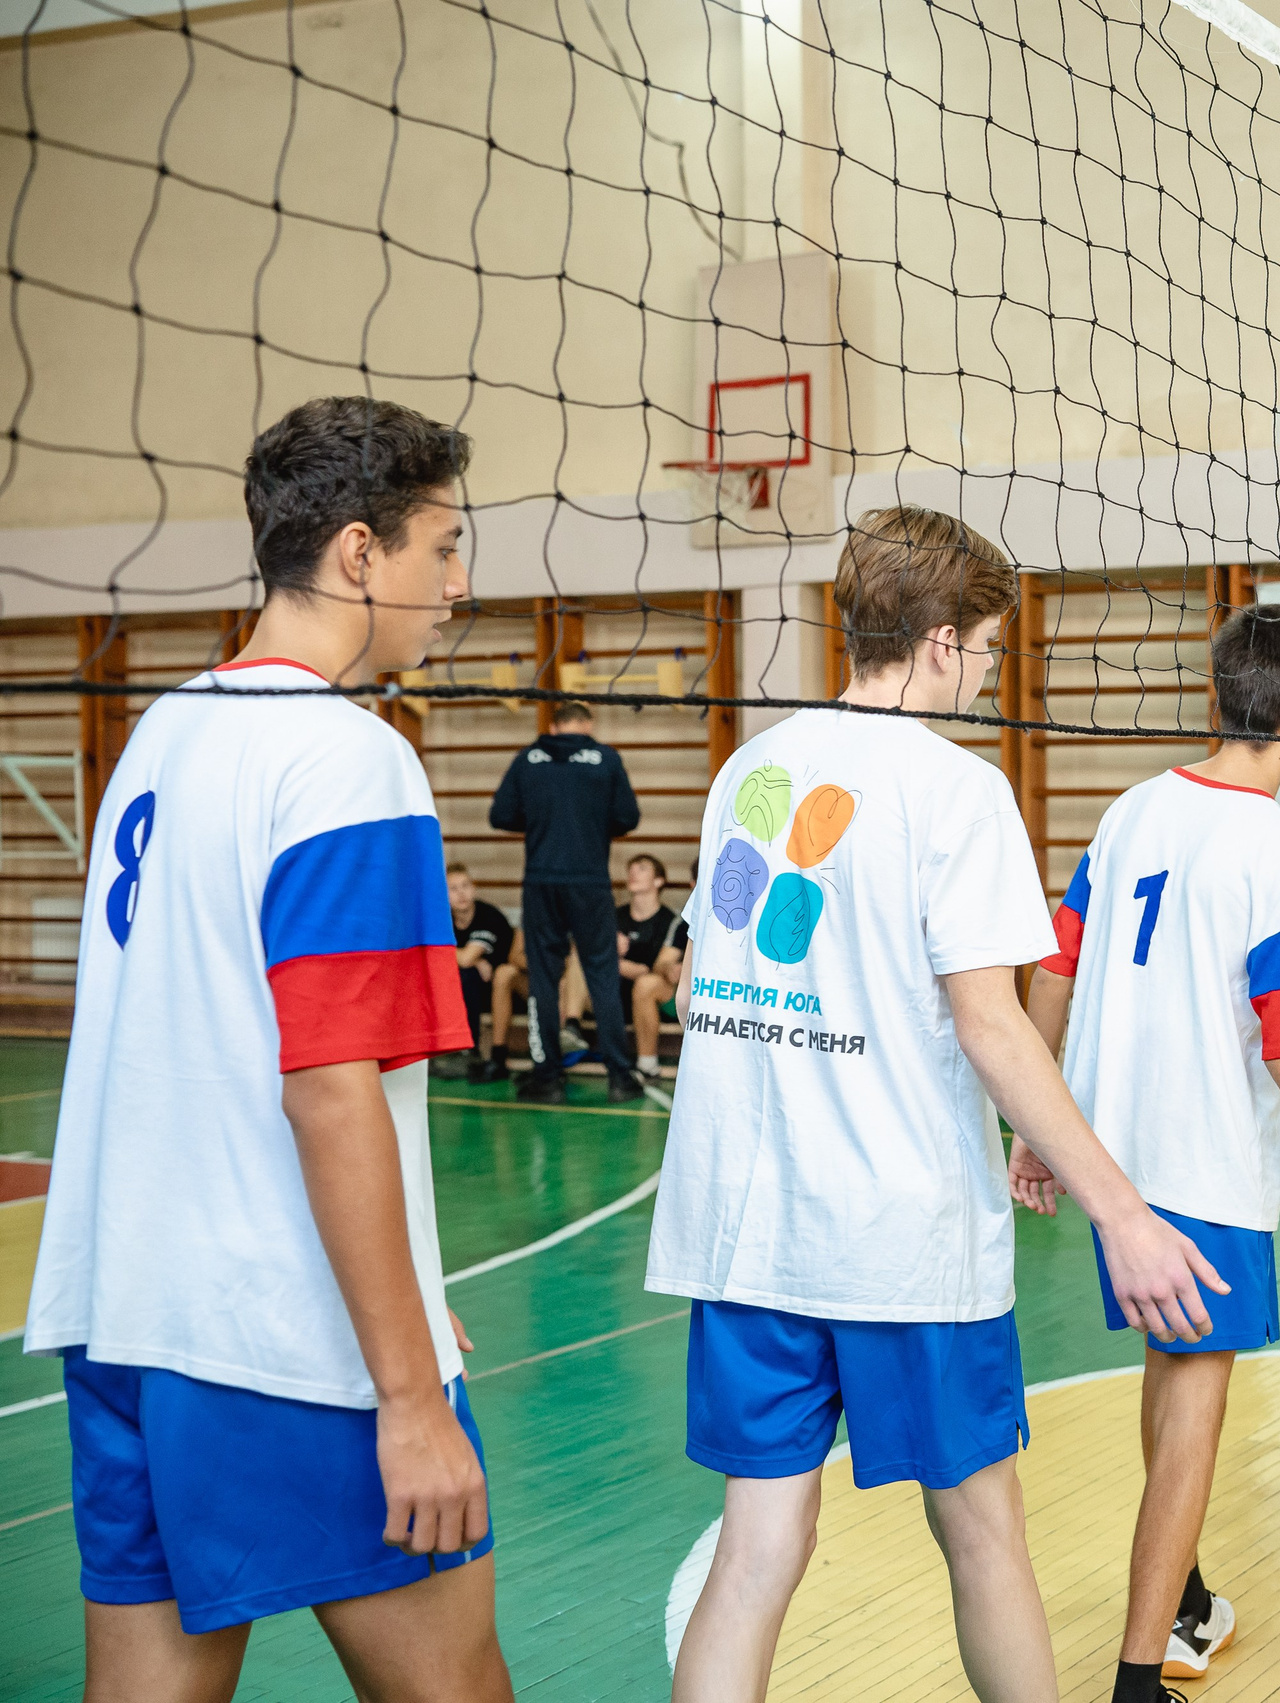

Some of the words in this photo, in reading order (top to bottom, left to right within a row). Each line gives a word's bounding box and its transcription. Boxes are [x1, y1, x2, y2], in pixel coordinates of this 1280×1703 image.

[1133, 869, 1170, 967] 1
[692, 976, 779, 1008] ЭНЕРГИЯ
[783, 991, 823, 1016] ЮГА
[789, 1028, 804, 1048] С
[808, 1029, 866, 1055] МЕНЯ
